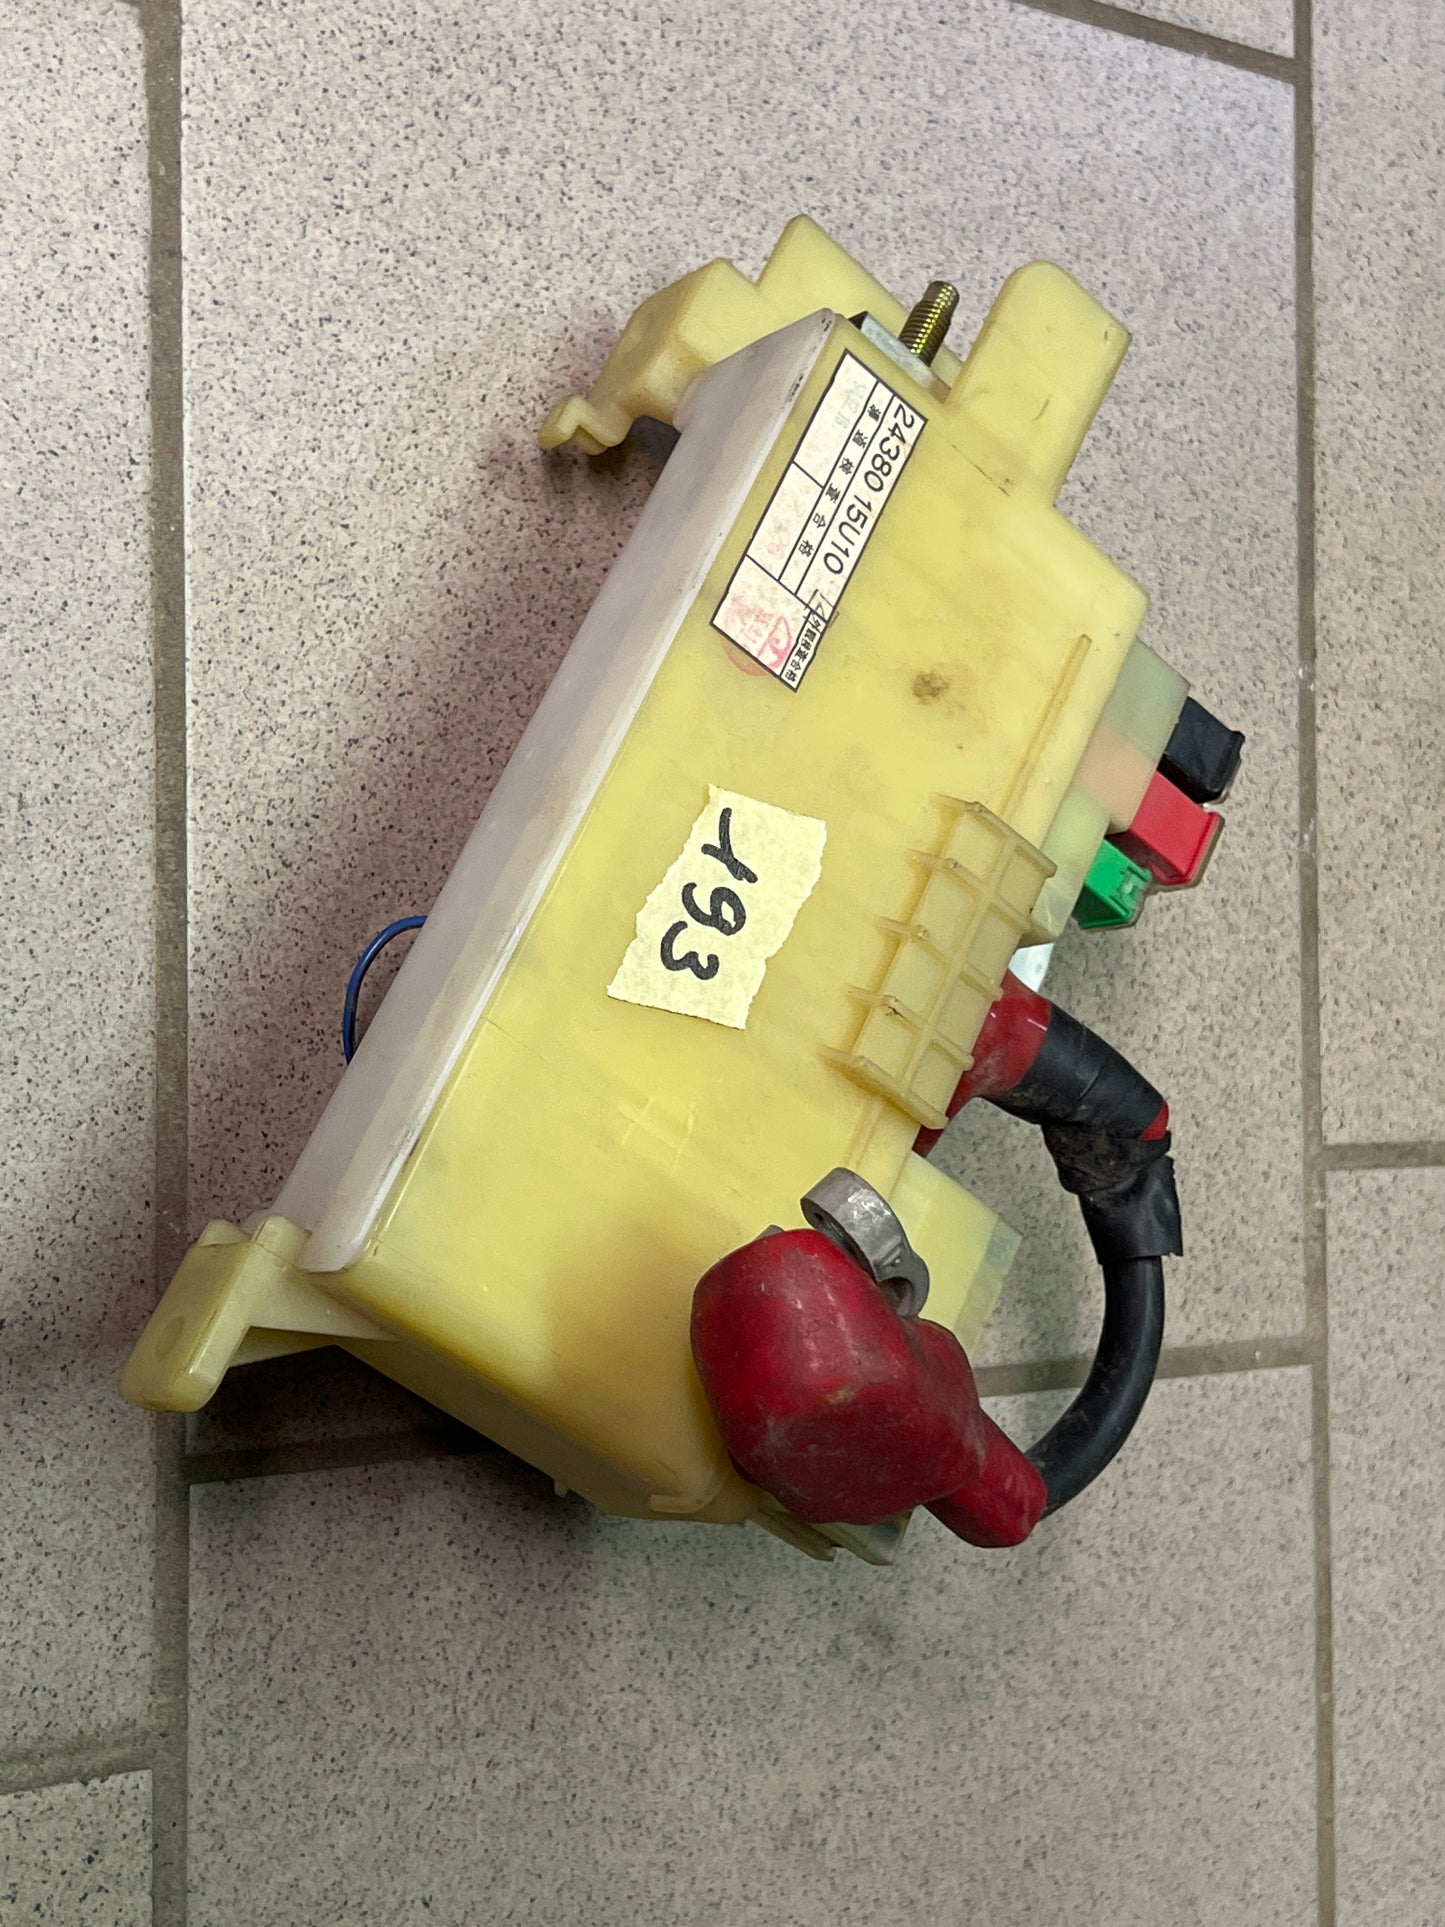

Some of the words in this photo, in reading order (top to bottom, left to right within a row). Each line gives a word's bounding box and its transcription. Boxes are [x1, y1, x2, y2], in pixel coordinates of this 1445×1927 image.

[863, 404, 914, 493] 24380
[823, 495, 873, 575] 15U10
[660, 807, 758, 980] 193
